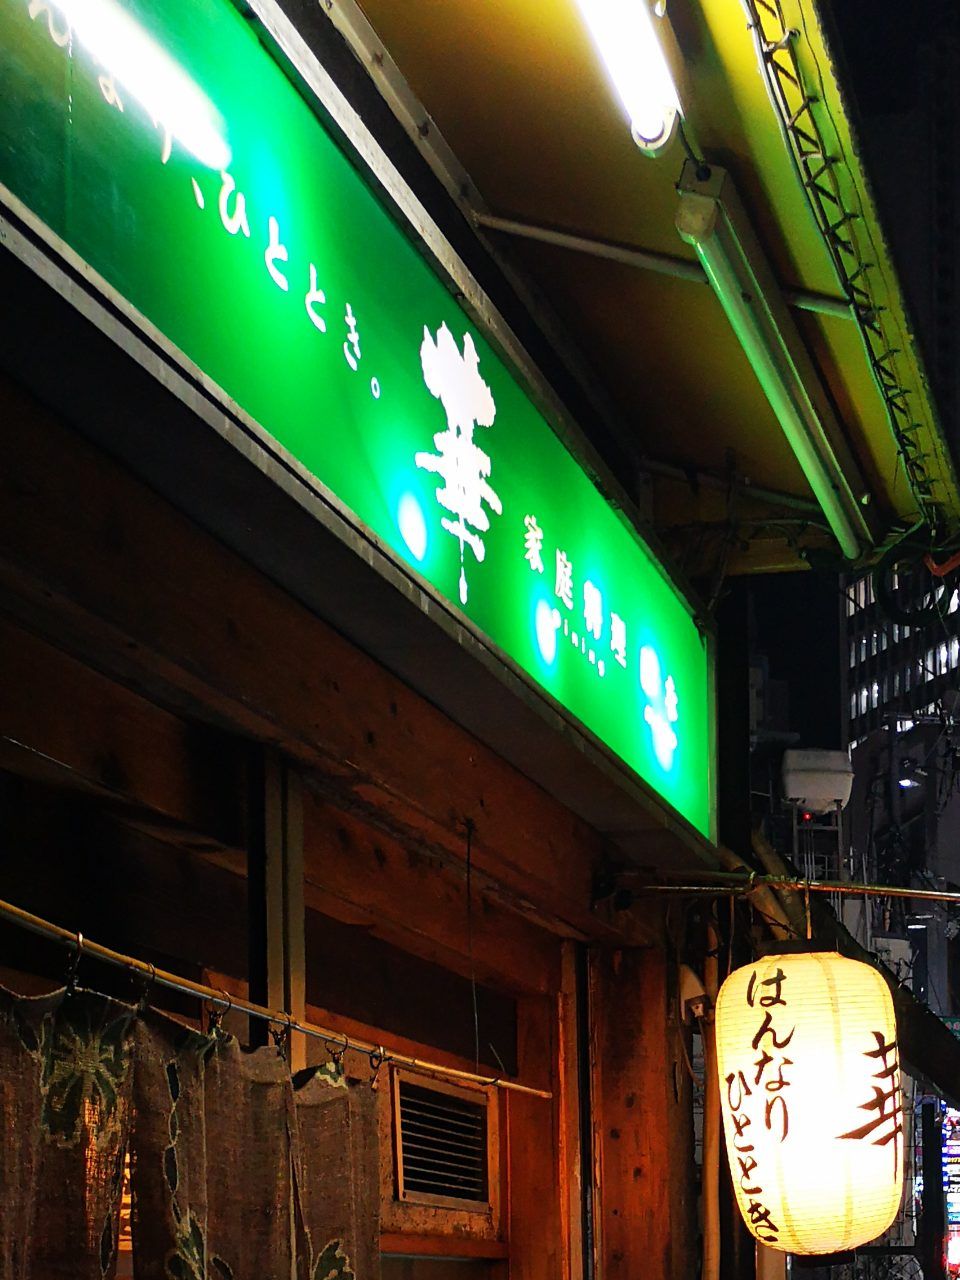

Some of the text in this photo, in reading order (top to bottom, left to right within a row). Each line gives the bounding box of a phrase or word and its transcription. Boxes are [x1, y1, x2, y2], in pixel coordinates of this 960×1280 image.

[746, 968, 796, 1144] はんなり
[725, 1069, 781, 1243] ひととき
